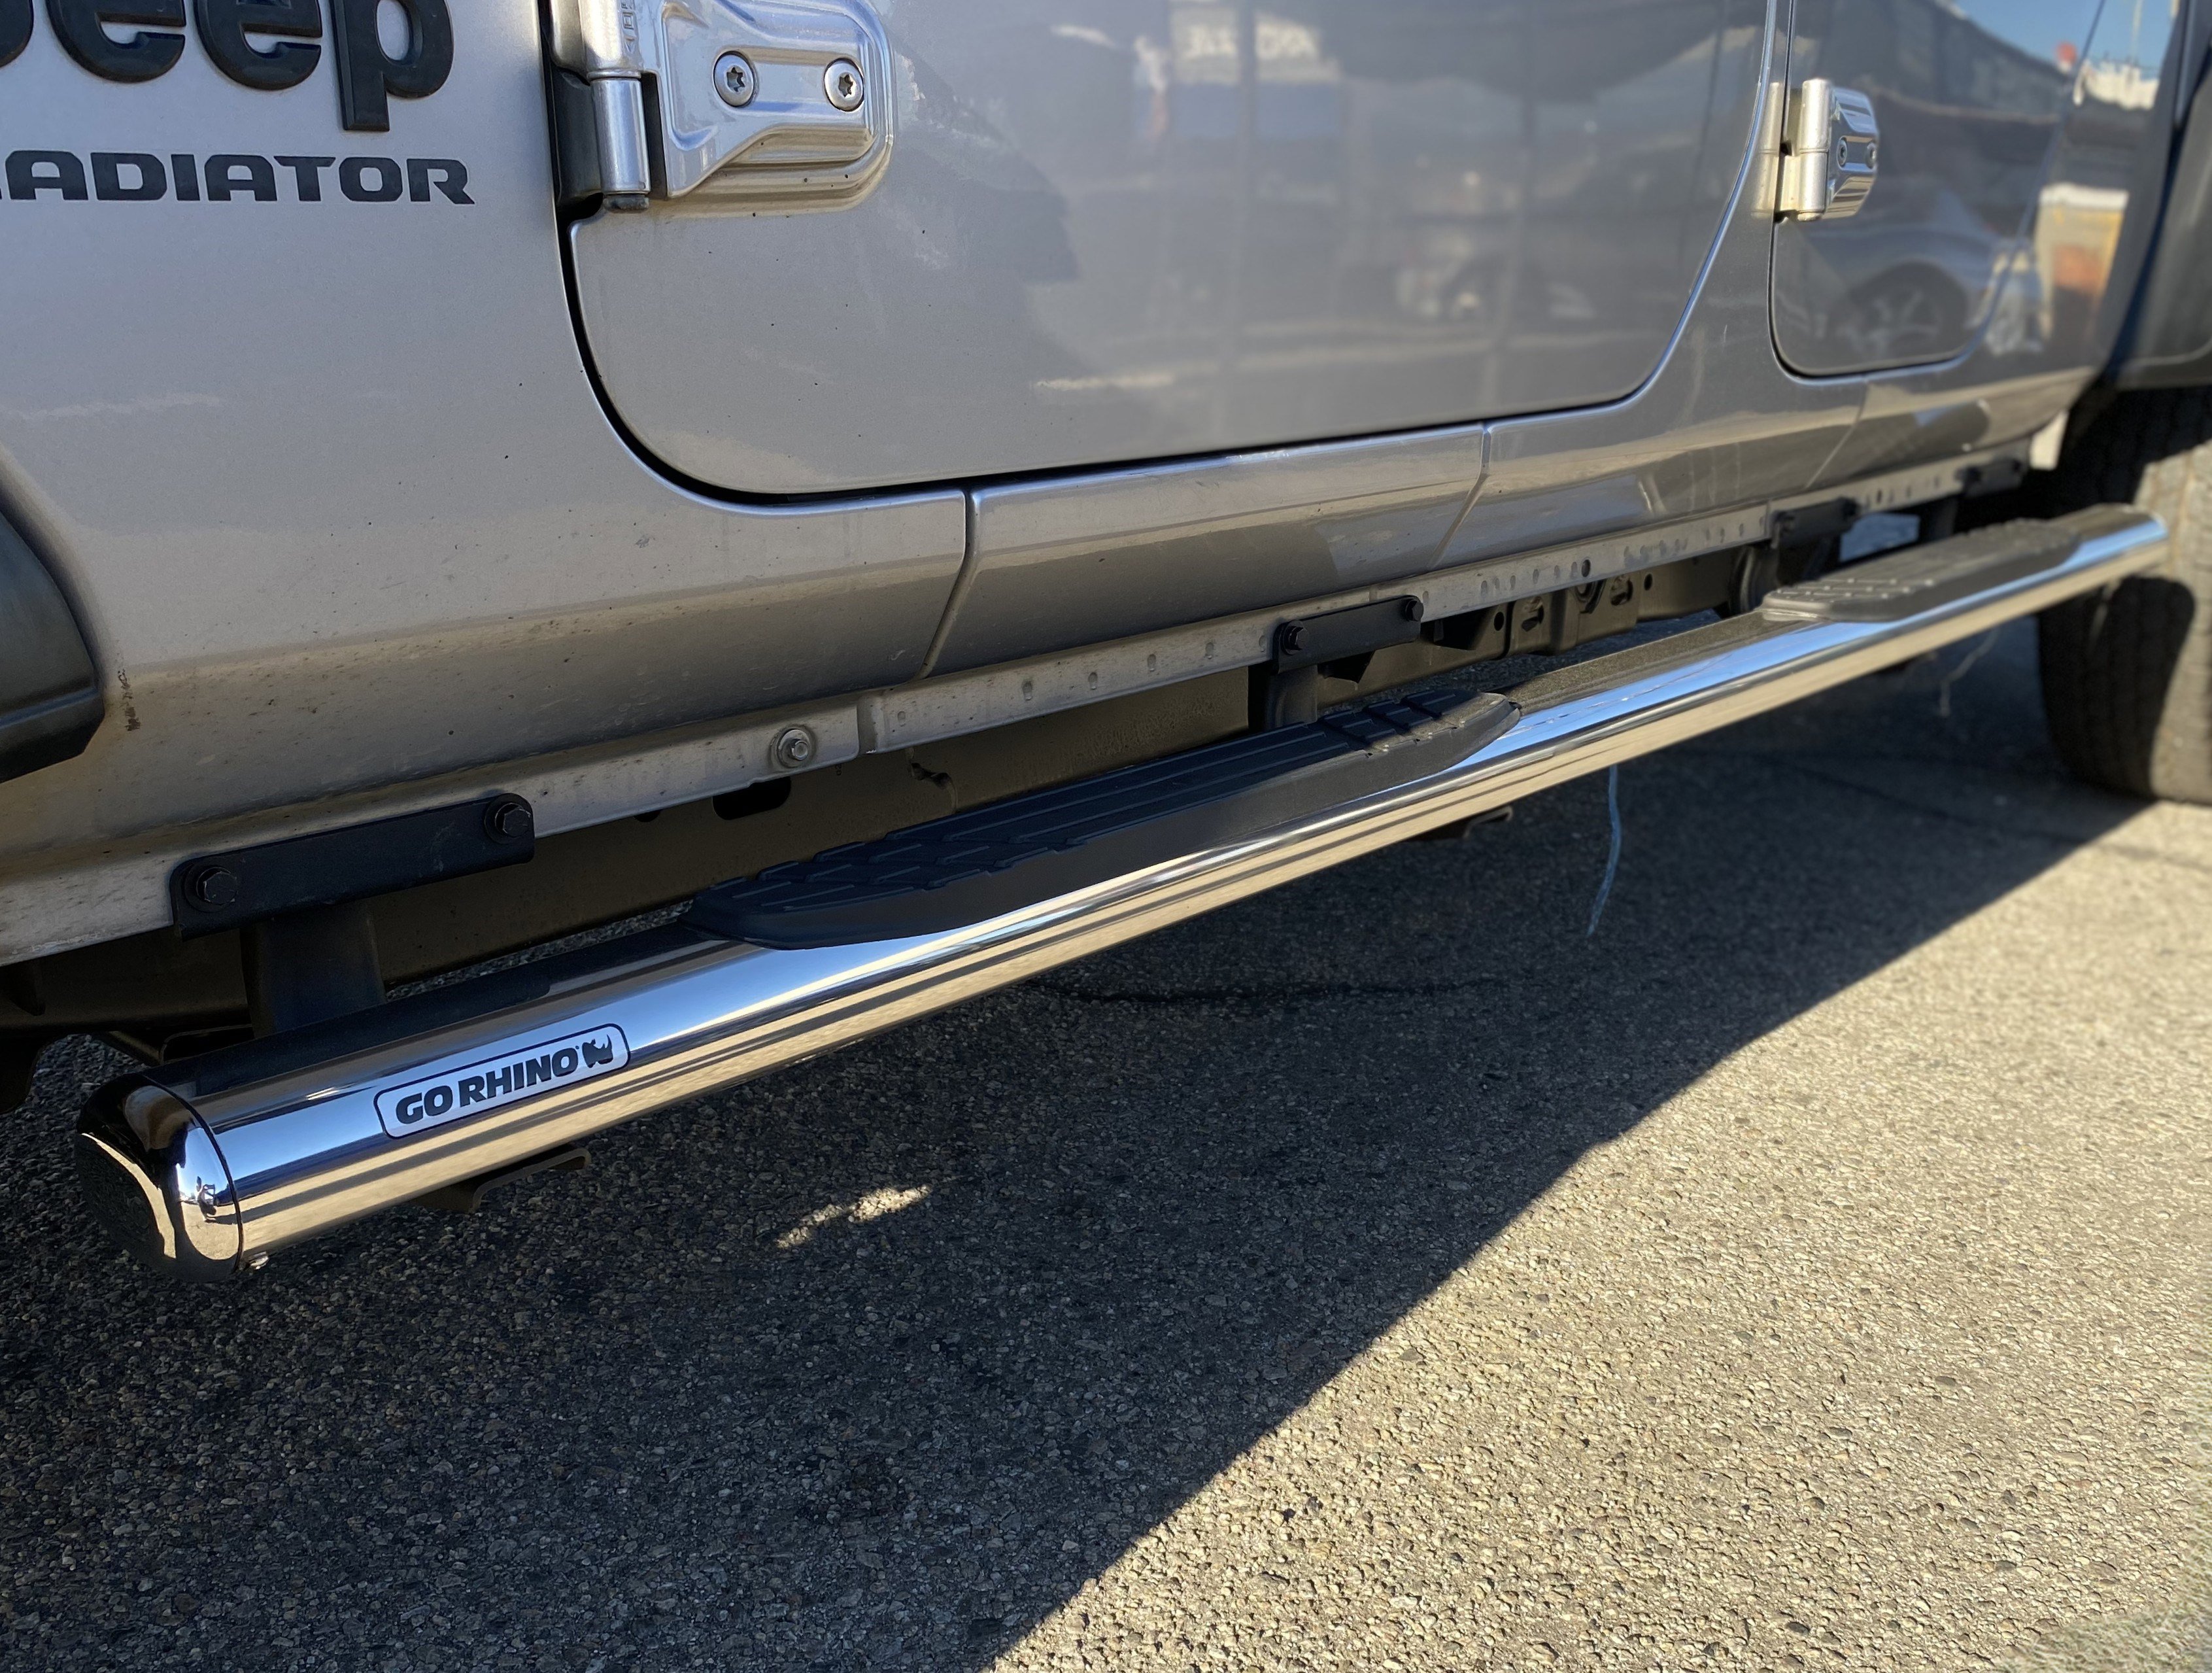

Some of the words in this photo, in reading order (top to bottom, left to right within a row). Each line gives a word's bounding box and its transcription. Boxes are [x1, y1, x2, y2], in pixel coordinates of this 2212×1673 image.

[0, 0, 454, 132] eep
[0, 150, 476, 205] ADIATOR
[396, 1085, 453, 1124] GO
[458, 1047, 579, 1108] RHINO
